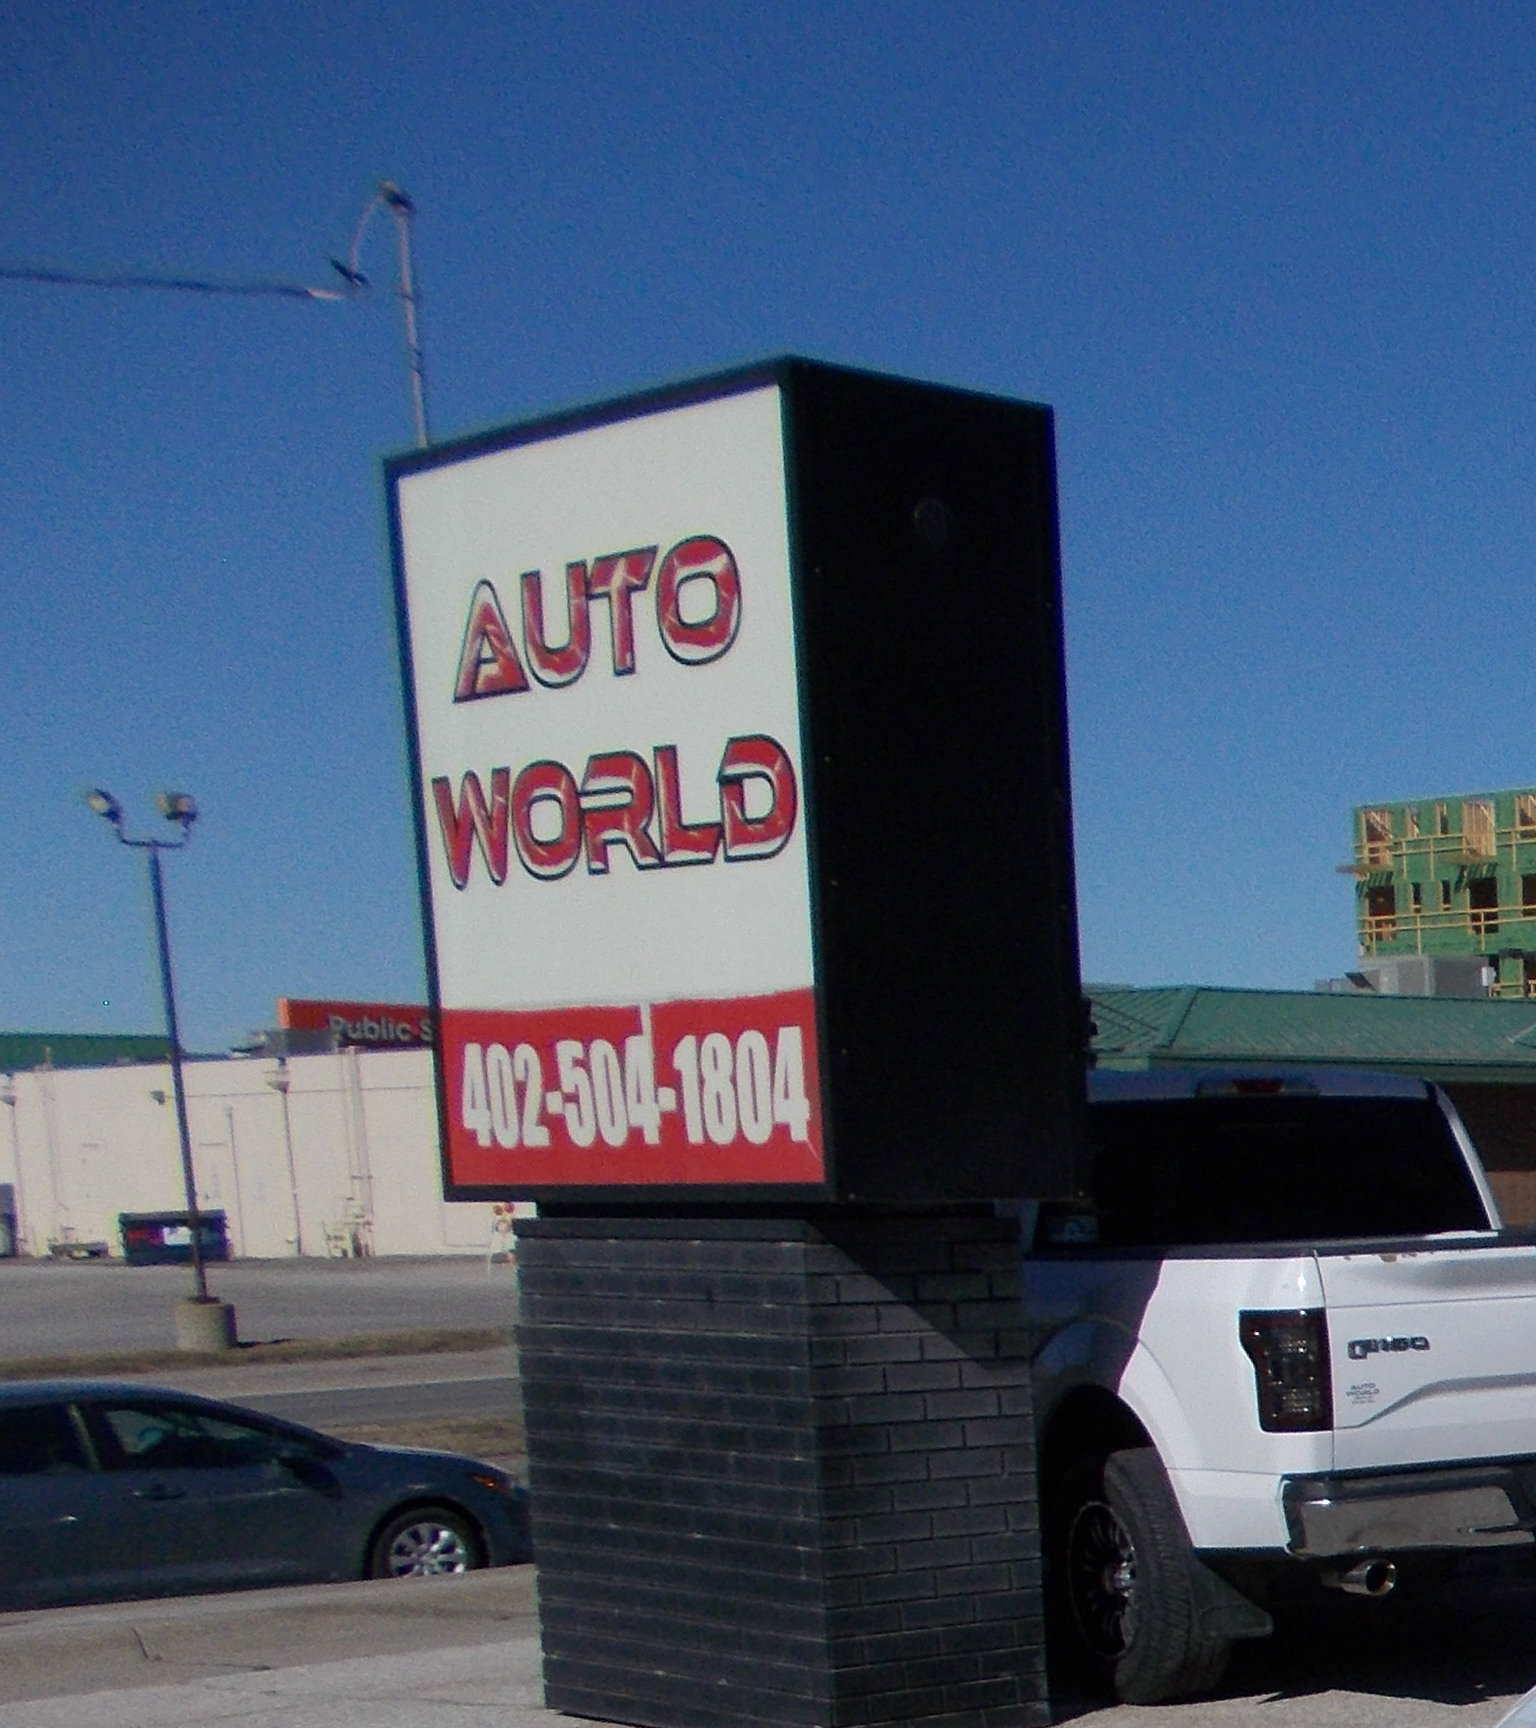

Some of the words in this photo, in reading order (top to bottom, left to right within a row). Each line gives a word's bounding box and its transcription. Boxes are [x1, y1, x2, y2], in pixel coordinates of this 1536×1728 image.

[452, 534, 743, 704] AUTO
[430, 733, 799, 891] WORLD
[329, 1015, 412, 1048] Public
[461, 1025, 811, 1149] 402-504-1804
